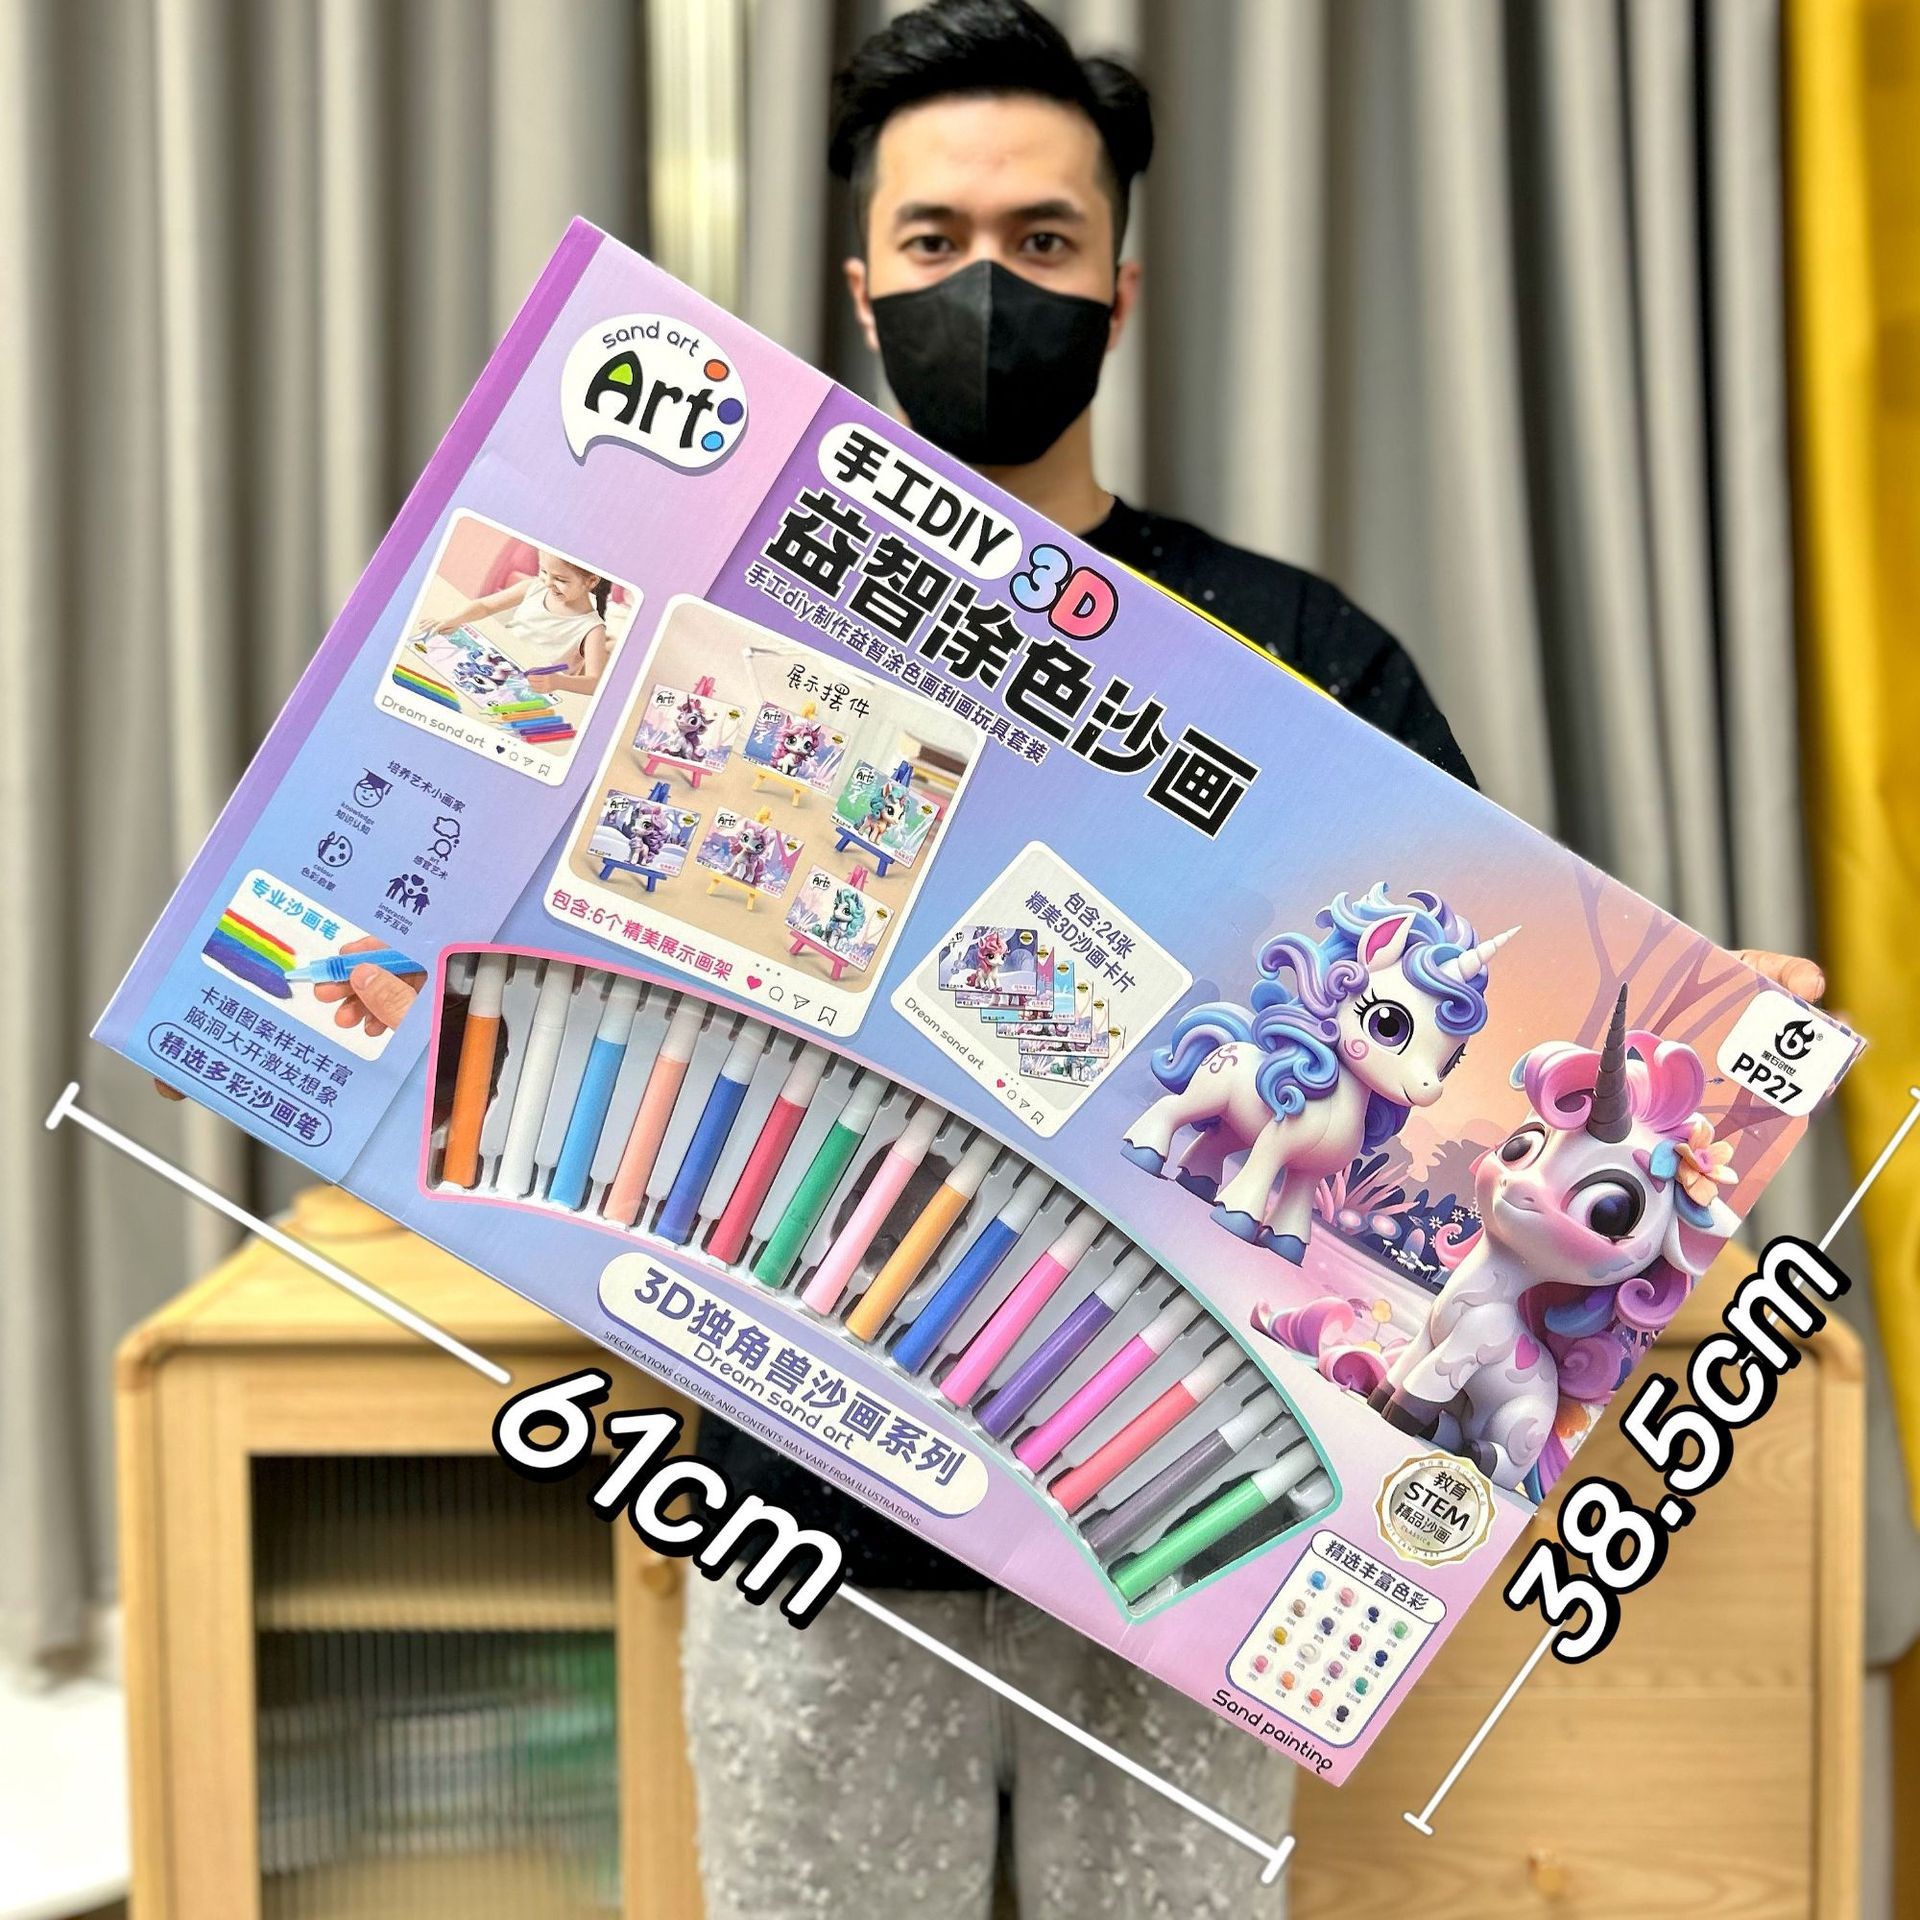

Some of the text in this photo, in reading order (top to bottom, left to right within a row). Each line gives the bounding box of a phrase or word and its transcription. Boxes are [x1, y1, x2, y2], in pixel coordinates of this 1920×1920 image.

[602, 320, 700, 357] sand art
[584, 350, 715, 448] Art
[834, 430, 1014, 567] 手工DIY
[1010, 544, 1118, 640] 3D
[746, 563, 1049, 764] 手工diy制作益智涂色画刮画玩具套装
[764, 487, 1260, 840] 益智涂色沙画
[787, 664, 869, 718] 展示摆件
[381, 695, 487, 749] Dream sand art
[335, 809, 371, 835] 知识认知
[386, 760, 466, 814] 培养艺术小画家
[250, 877, 341, 941] 专业沙画笔
[374, 909, 410, 935] 亲子互动
[552, 889, 734, 981] 包含:6个精美展示画架
[1025, 890, 1136, 994] 精美3D沙画卡片
[1063, 892, 1136, 960] 包含:24张
[184, 1005, 339, 1108] 脑洞大开激发想象
[200, 986, 354, 1087] 卡通图案样式丰富
[904, 996, 985, 1071] Dream sand art
[159, 1030, 322, 1141] 精选多彩沙画笔
[1730, 1052, 1803, 1104] PP27
[634, 1267, 968, 1487] 3D独角兽沙画系列
[694, 1342, 854, 1450] Dream sand art
[604, 1332, 920, 1526] SPECIFICATIONS COLOURS AND CONTENTS MAY VARY FROM ILLUSTRATIONS
[1395, 1502, 1452, 1544] 精品沙画
[1404, 1481, 1470, 1531] STEM
[1433, 1471, 1470, 1500] 教育
[1325, 1540, 1429, 1611] 精选丰富色彩
[1212, 1689, 1333, 1774] Sand painting
